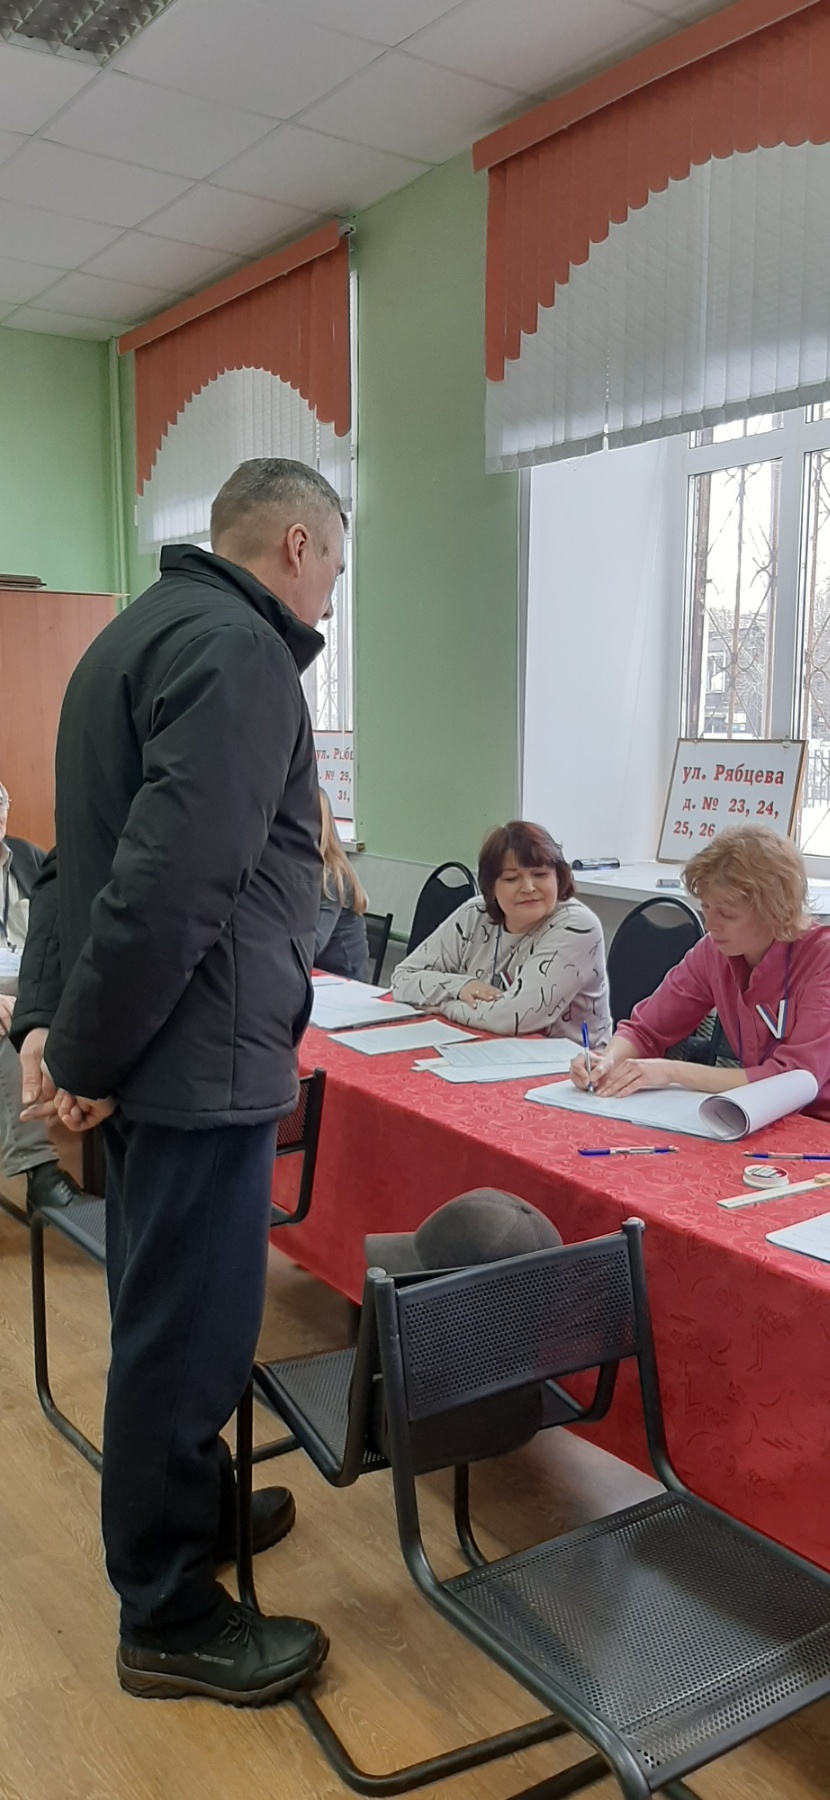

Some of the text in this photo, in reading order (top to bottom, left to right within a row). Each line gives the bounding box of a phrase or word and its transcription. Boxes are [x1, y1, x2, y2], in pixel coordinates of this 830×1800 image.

[339, 771, 352, 784] 29,
[682, 763, 785, 786] ул. Рябцева
[338, 789, 350, 803] 31,
[682, 796, 779, 819] д. № 23, 24,
[673, 821, 716, 839] 25, 26
